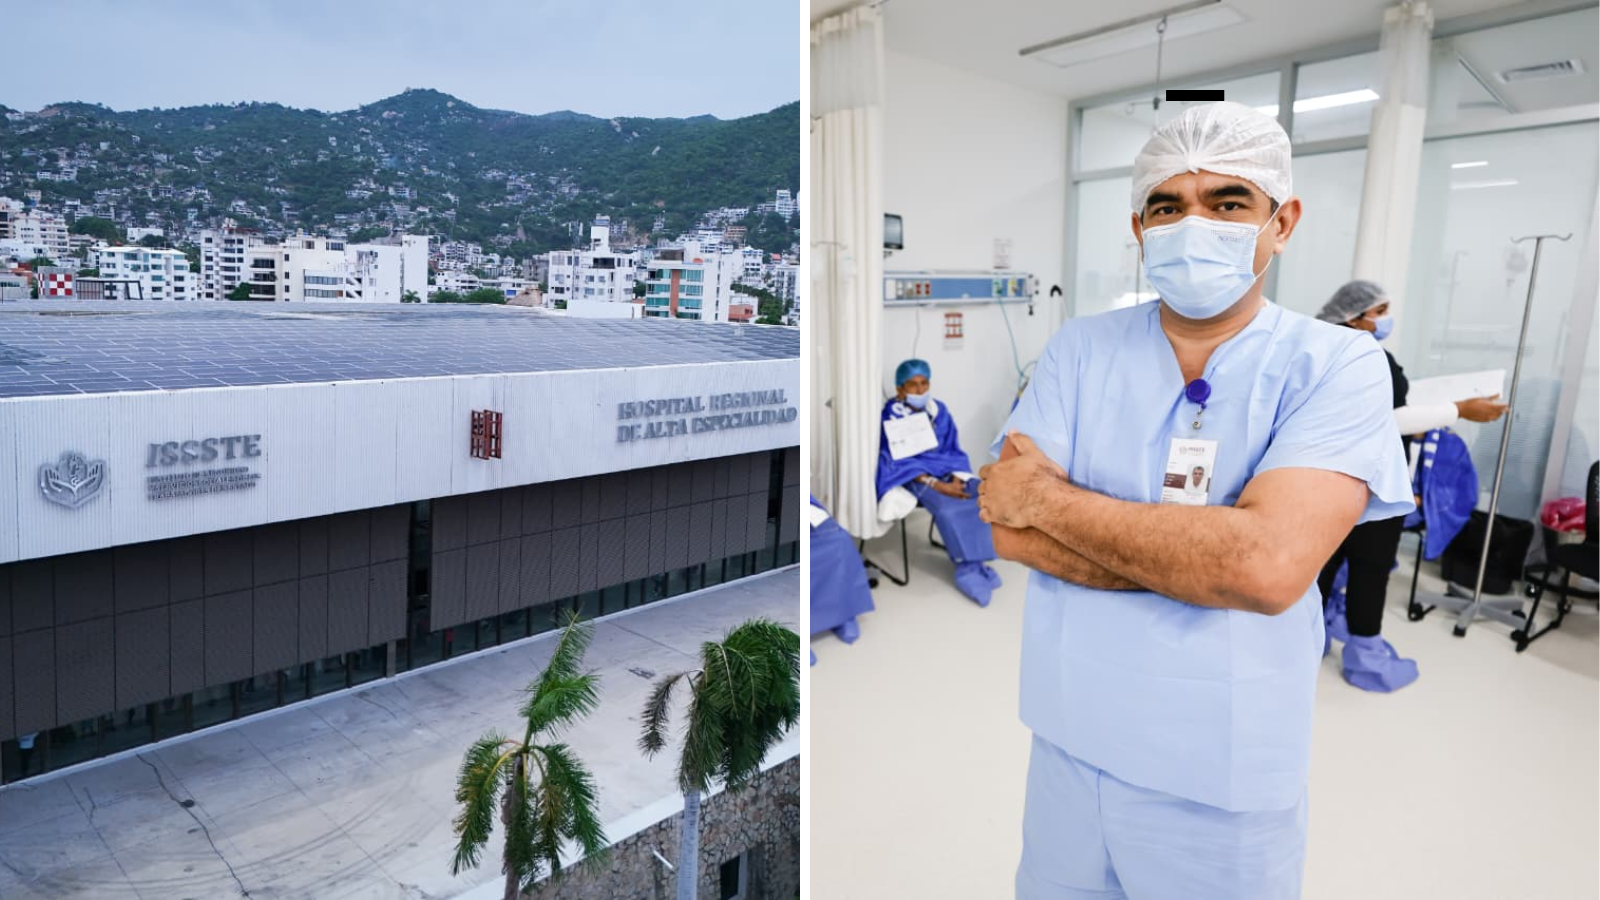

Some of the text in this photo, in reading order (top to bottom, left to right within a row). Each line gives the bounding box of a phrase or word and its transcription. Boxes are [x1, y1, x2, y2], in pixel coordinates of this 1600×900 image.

[617, 389, 788, 420] HOSPITAL REGIONAL
[616, 407, 798, 443] DE ALTA ESPECIALIDAD
[146, 434, 262, 468] ISSSTE
